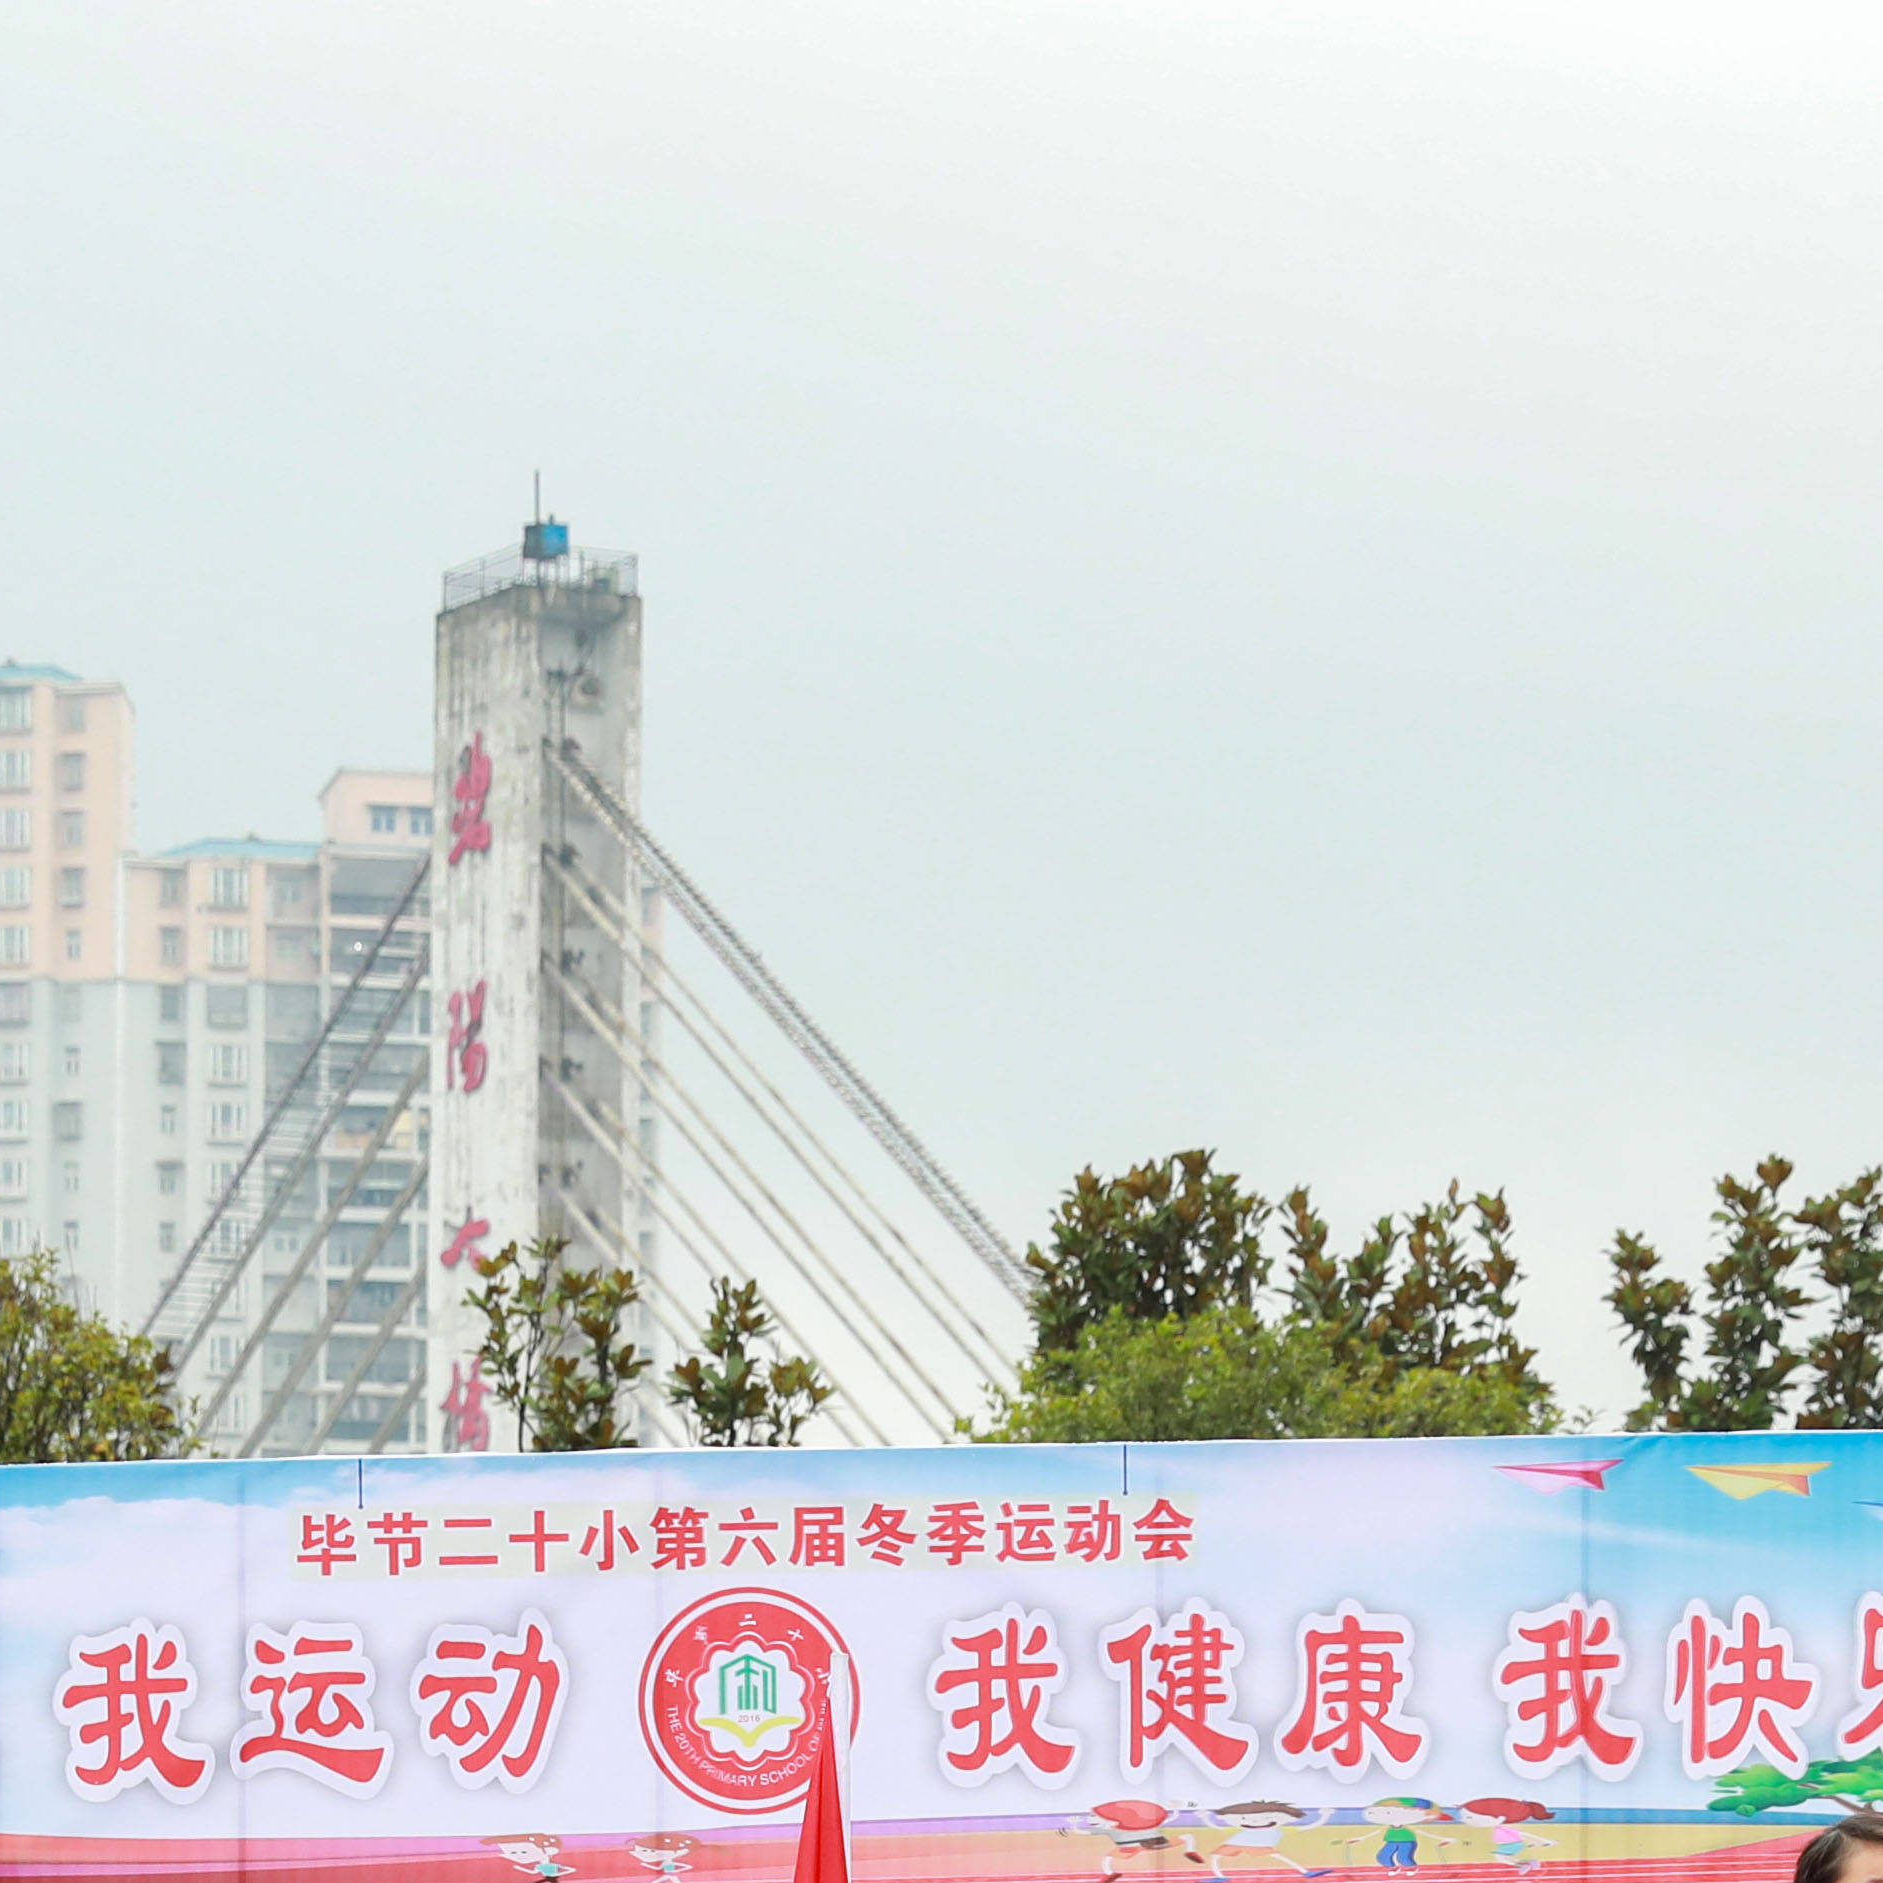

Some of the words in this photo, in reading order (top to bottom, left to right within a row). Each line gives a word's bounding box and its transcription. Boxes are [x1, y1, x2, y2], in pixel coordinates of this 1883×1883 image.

[296, 1498, 1194, 1576] 毕节二十小第六届冬季运动会
[63, 1624, 560, 1788] 我运动
[935, 1613, 1422, 1774] 我健康
[737, 1714, 761, 1723] 2016
[760, 1753, 814, 1786] SCHOOL
